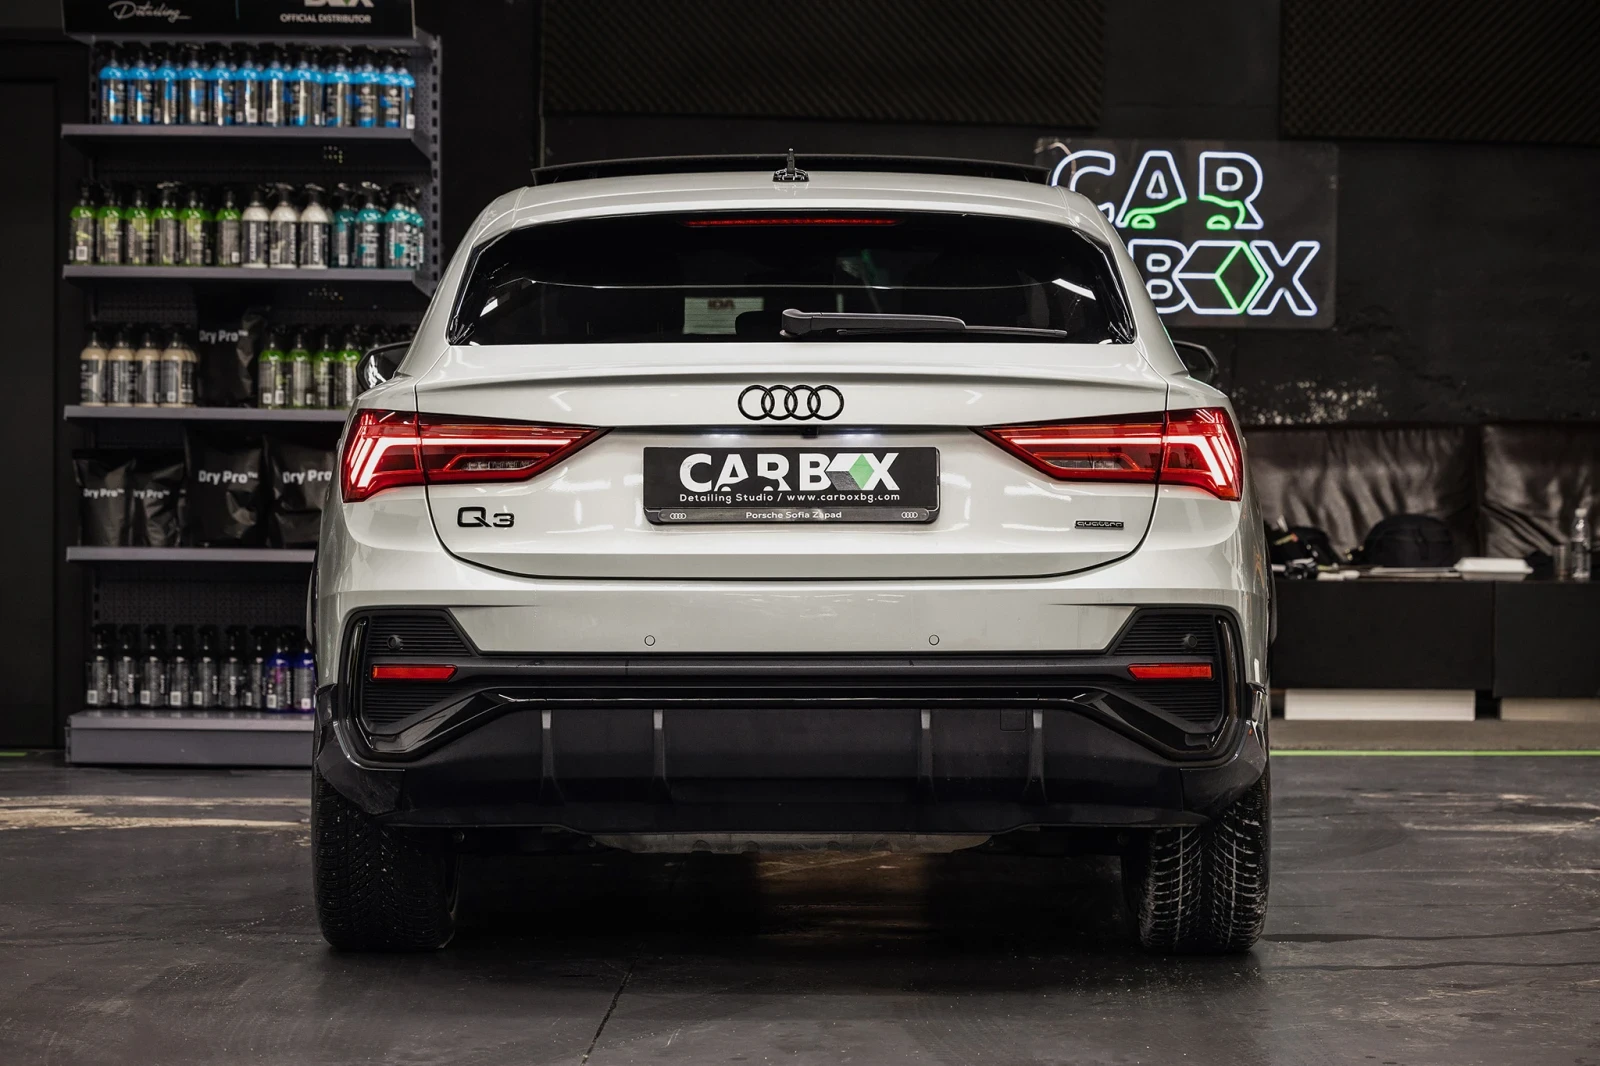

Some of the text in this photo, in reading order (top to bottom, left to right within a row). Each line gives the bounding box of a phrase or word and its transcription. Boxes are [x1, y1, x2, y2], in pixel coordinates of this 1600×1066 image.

[280, 14, 371, 23] OFFICIAL DISTRIBUTOR
[1051, 150, 1264, 230] CAR
[1128, 239, 1321, 316] BOX
[200, 330, 217, 344] Dry
[198, 470, 220, 485] Dry
[282, 471, 305, 485] Dry
[679, 453, 900, 492] CARBOX
[680, 493, 732, 504] Detailing
[736, 493, 773, 502] Studio
[786, 492, 900, 503] www.carboxbg.com
[457, 506, 515, 528] Q3
[745, 511, 842, 520] Porsche Sofia Zapad
